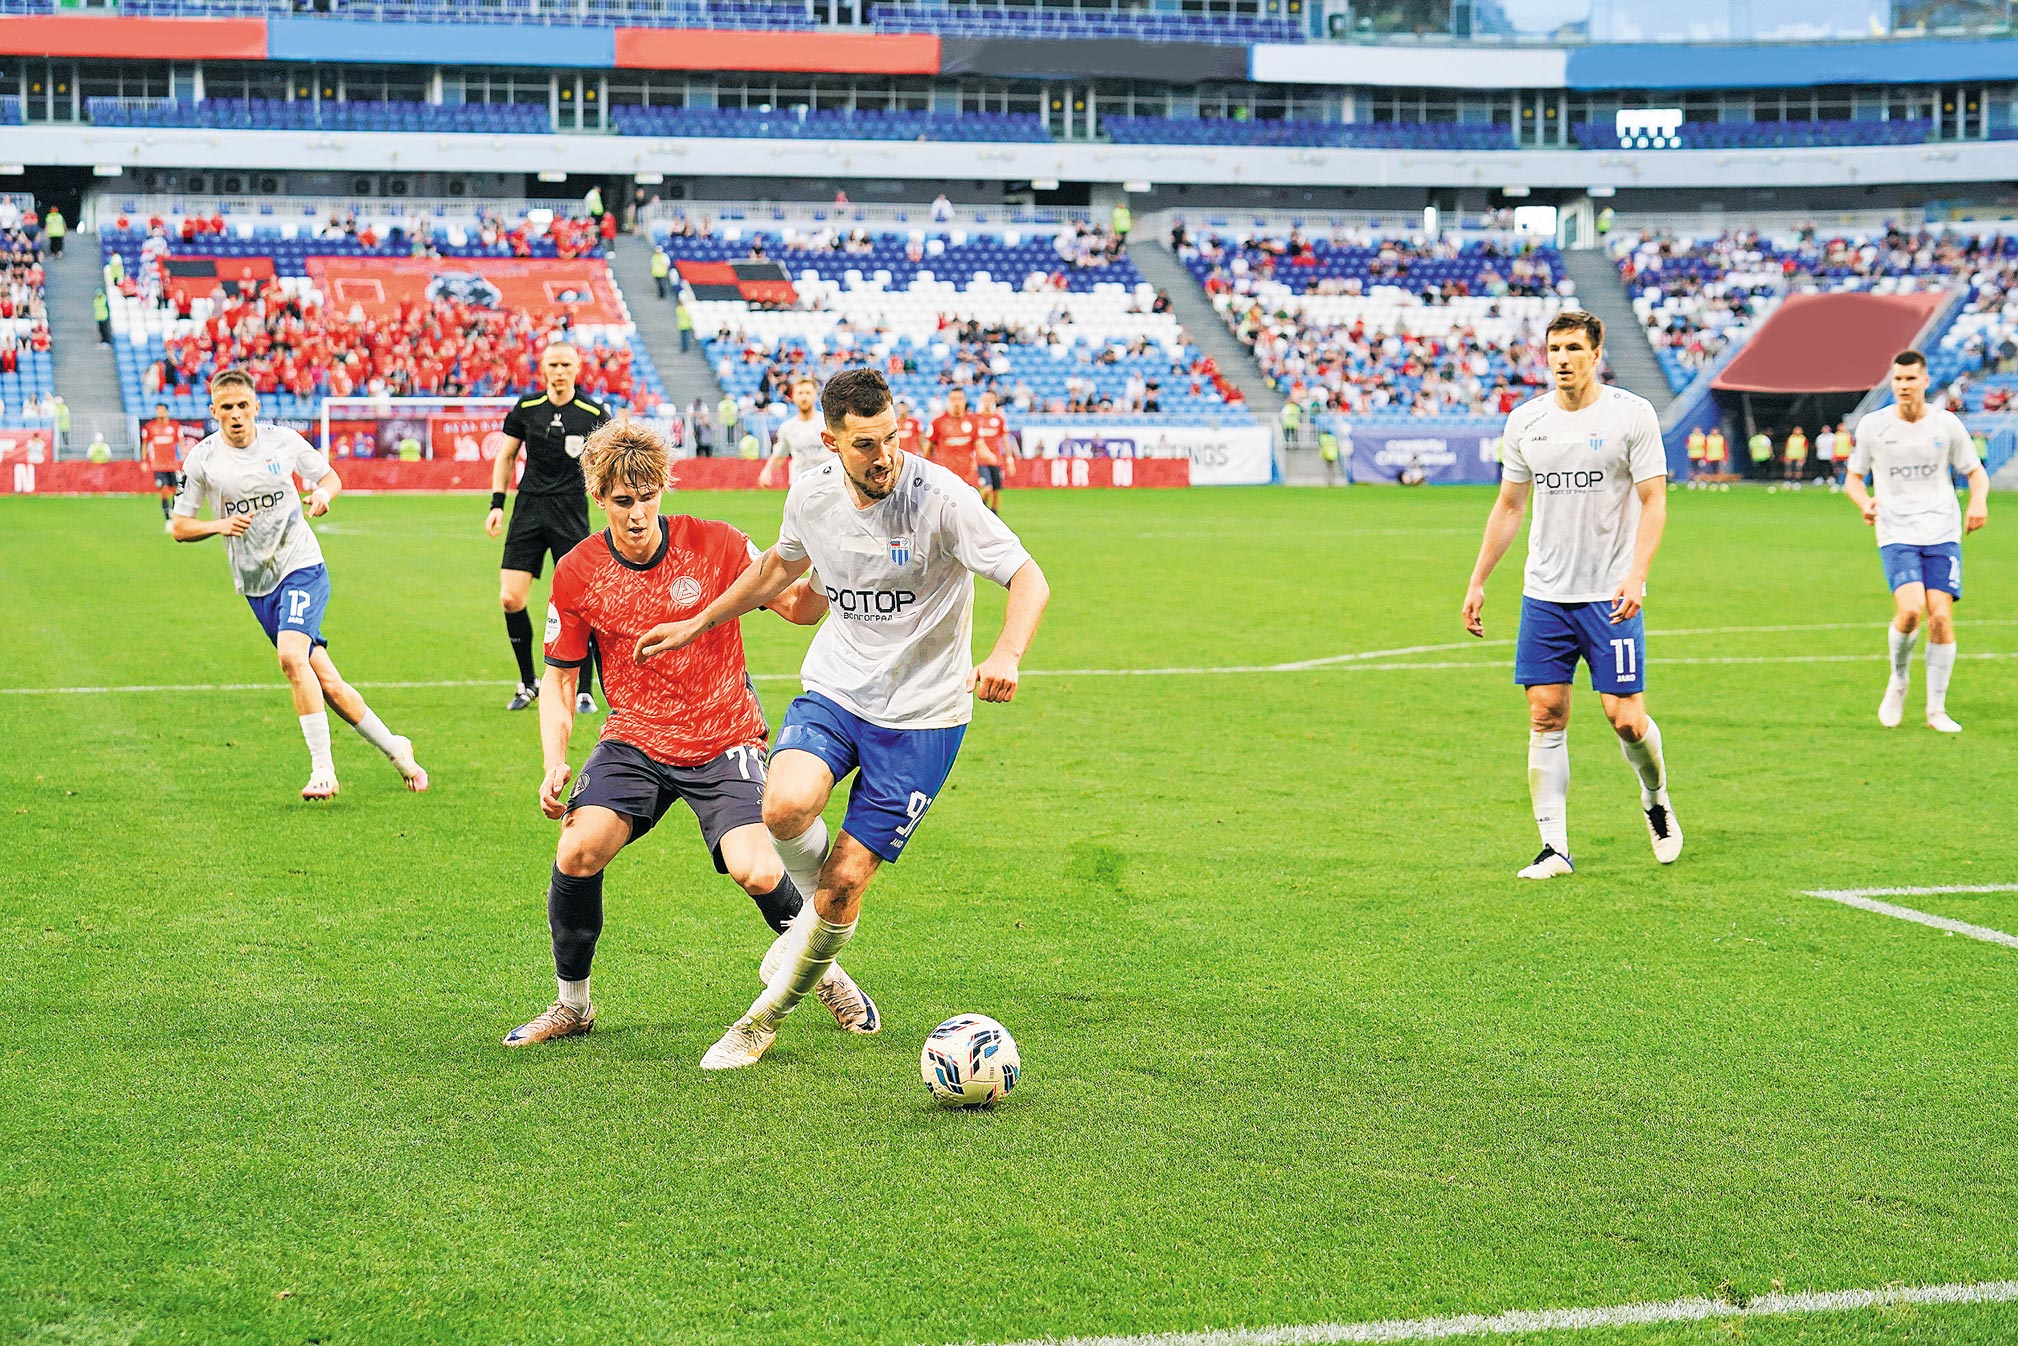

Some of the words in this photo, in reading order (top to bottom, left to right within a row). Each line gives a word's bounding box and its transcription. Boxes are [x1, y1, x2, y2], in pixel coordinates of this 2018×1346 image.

[1535, 471, 1604, 489] РОТОР
[825, 585, 917, 613] РОТОР
[1609, 638, 1636, 674] 11
